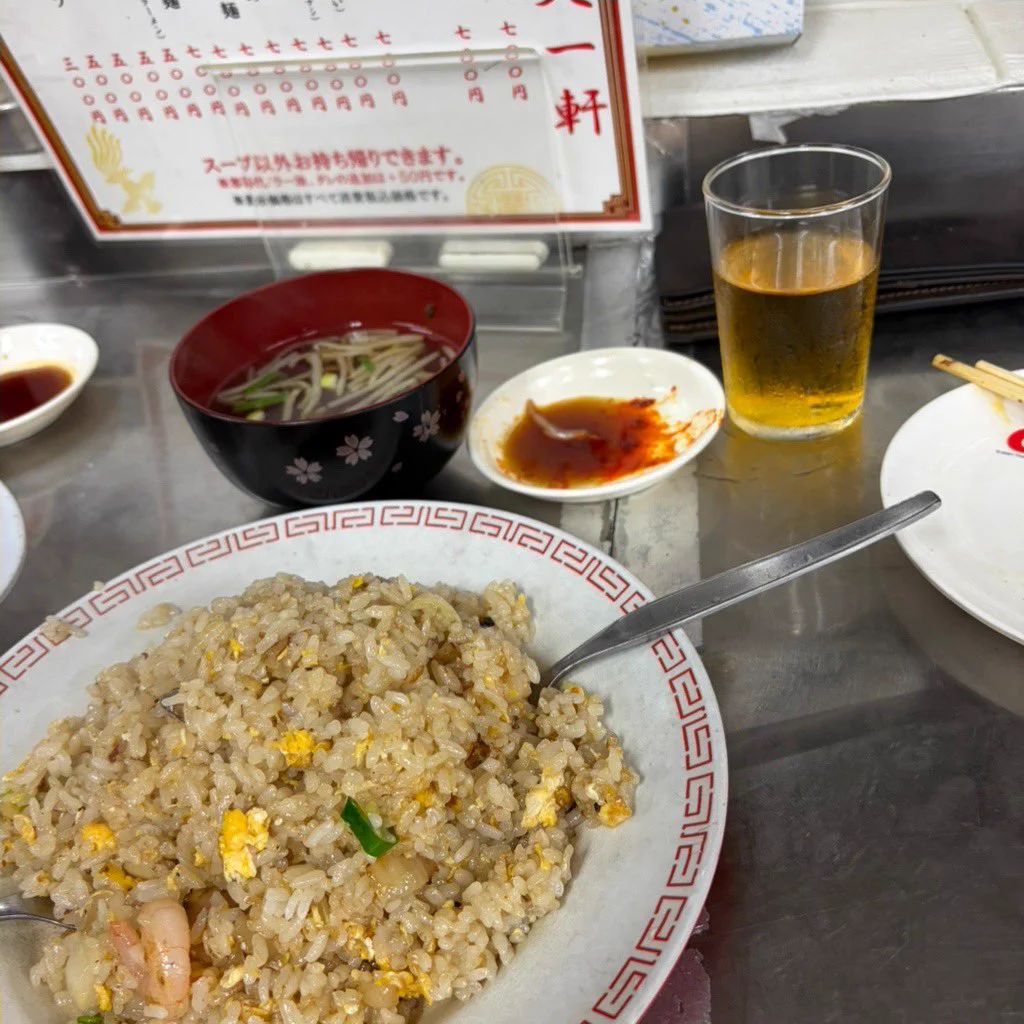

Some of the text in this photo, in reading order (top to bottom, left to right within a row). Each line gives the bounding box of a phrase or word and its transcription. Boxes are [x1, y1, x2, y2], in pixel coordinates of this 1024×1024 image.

[202, 144, 464, 174] スープ以外お持ち帰りできます。
